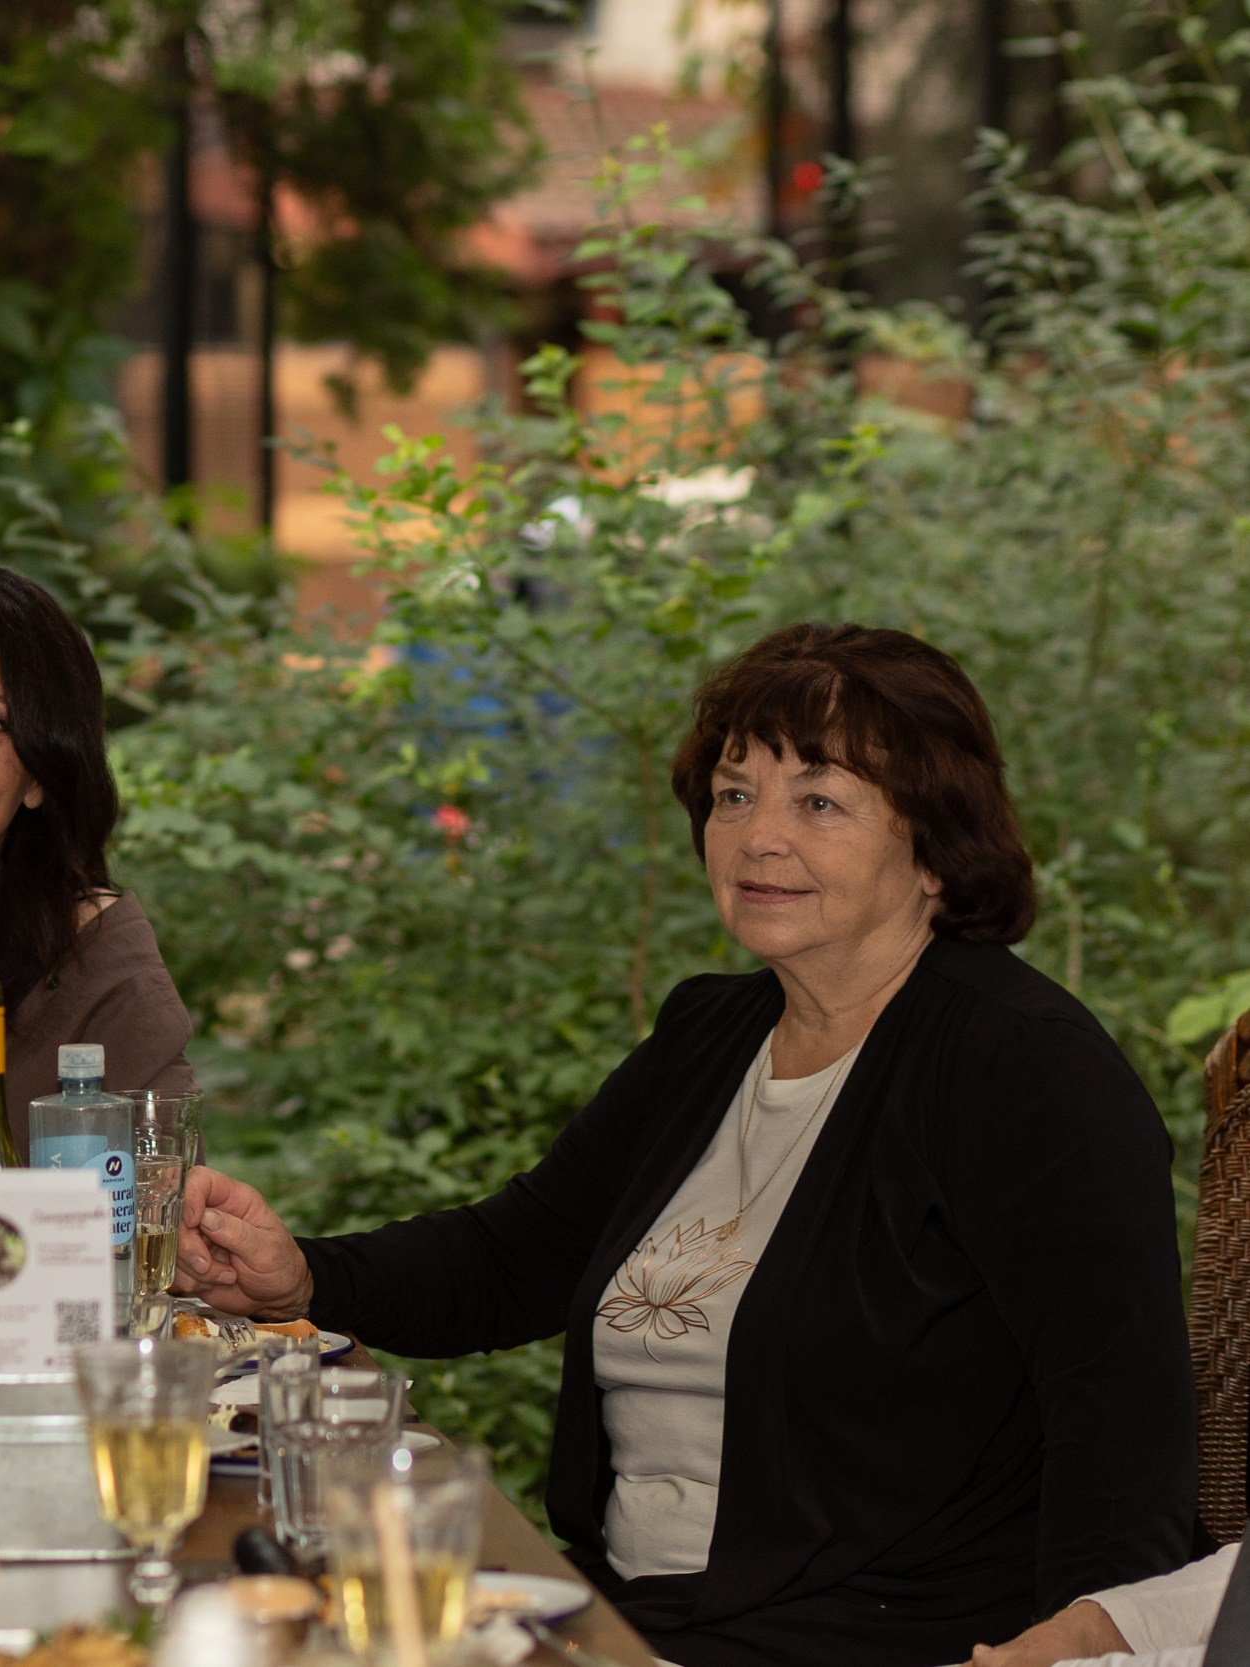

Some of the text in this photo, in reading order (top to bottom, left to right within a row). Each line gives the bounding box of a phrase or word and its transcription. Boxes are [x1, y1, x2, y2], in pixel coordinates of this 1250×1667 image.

[108, 1161, 120, 1171] N
[109, 1201, 135, 1217] neral
[109, 1221, 132, 1234] ater
